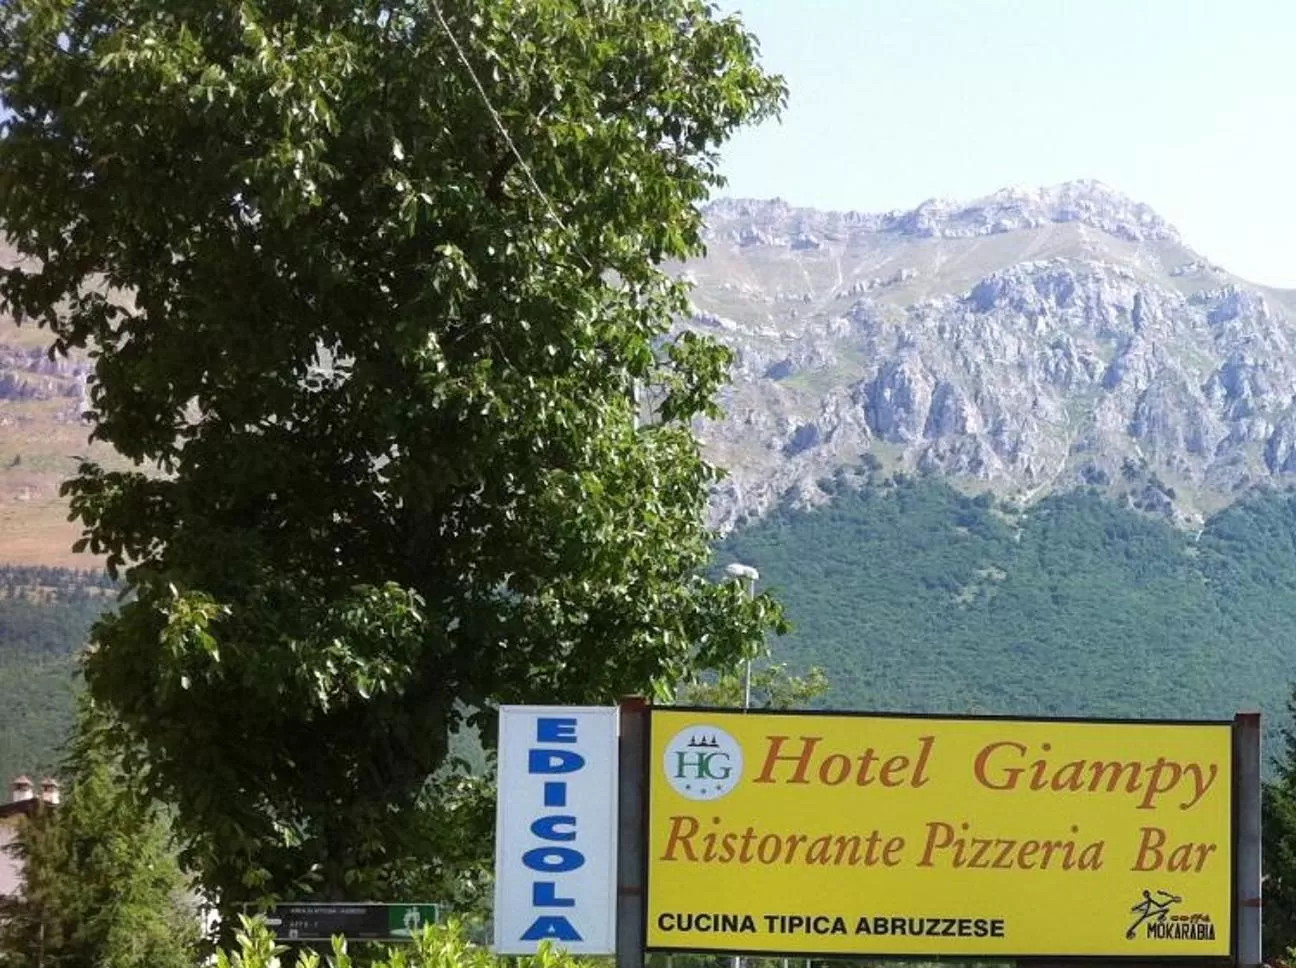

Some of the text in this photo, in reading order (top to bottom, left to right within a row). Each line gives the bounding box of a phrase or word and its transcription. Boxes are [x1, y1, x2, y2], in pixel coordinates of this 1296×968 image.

[753, 735, 1218, 810] Hotel Giampy
[519, 717, 586, 941] EDICOLA
[659, 816, 1217, 873] Ristorante Pizzeria Bar
[657, 913, 1005, 937] CUCINA TIPICA ABRUZZESE
[1146, 922, 1216, 941] MOKARABIA
